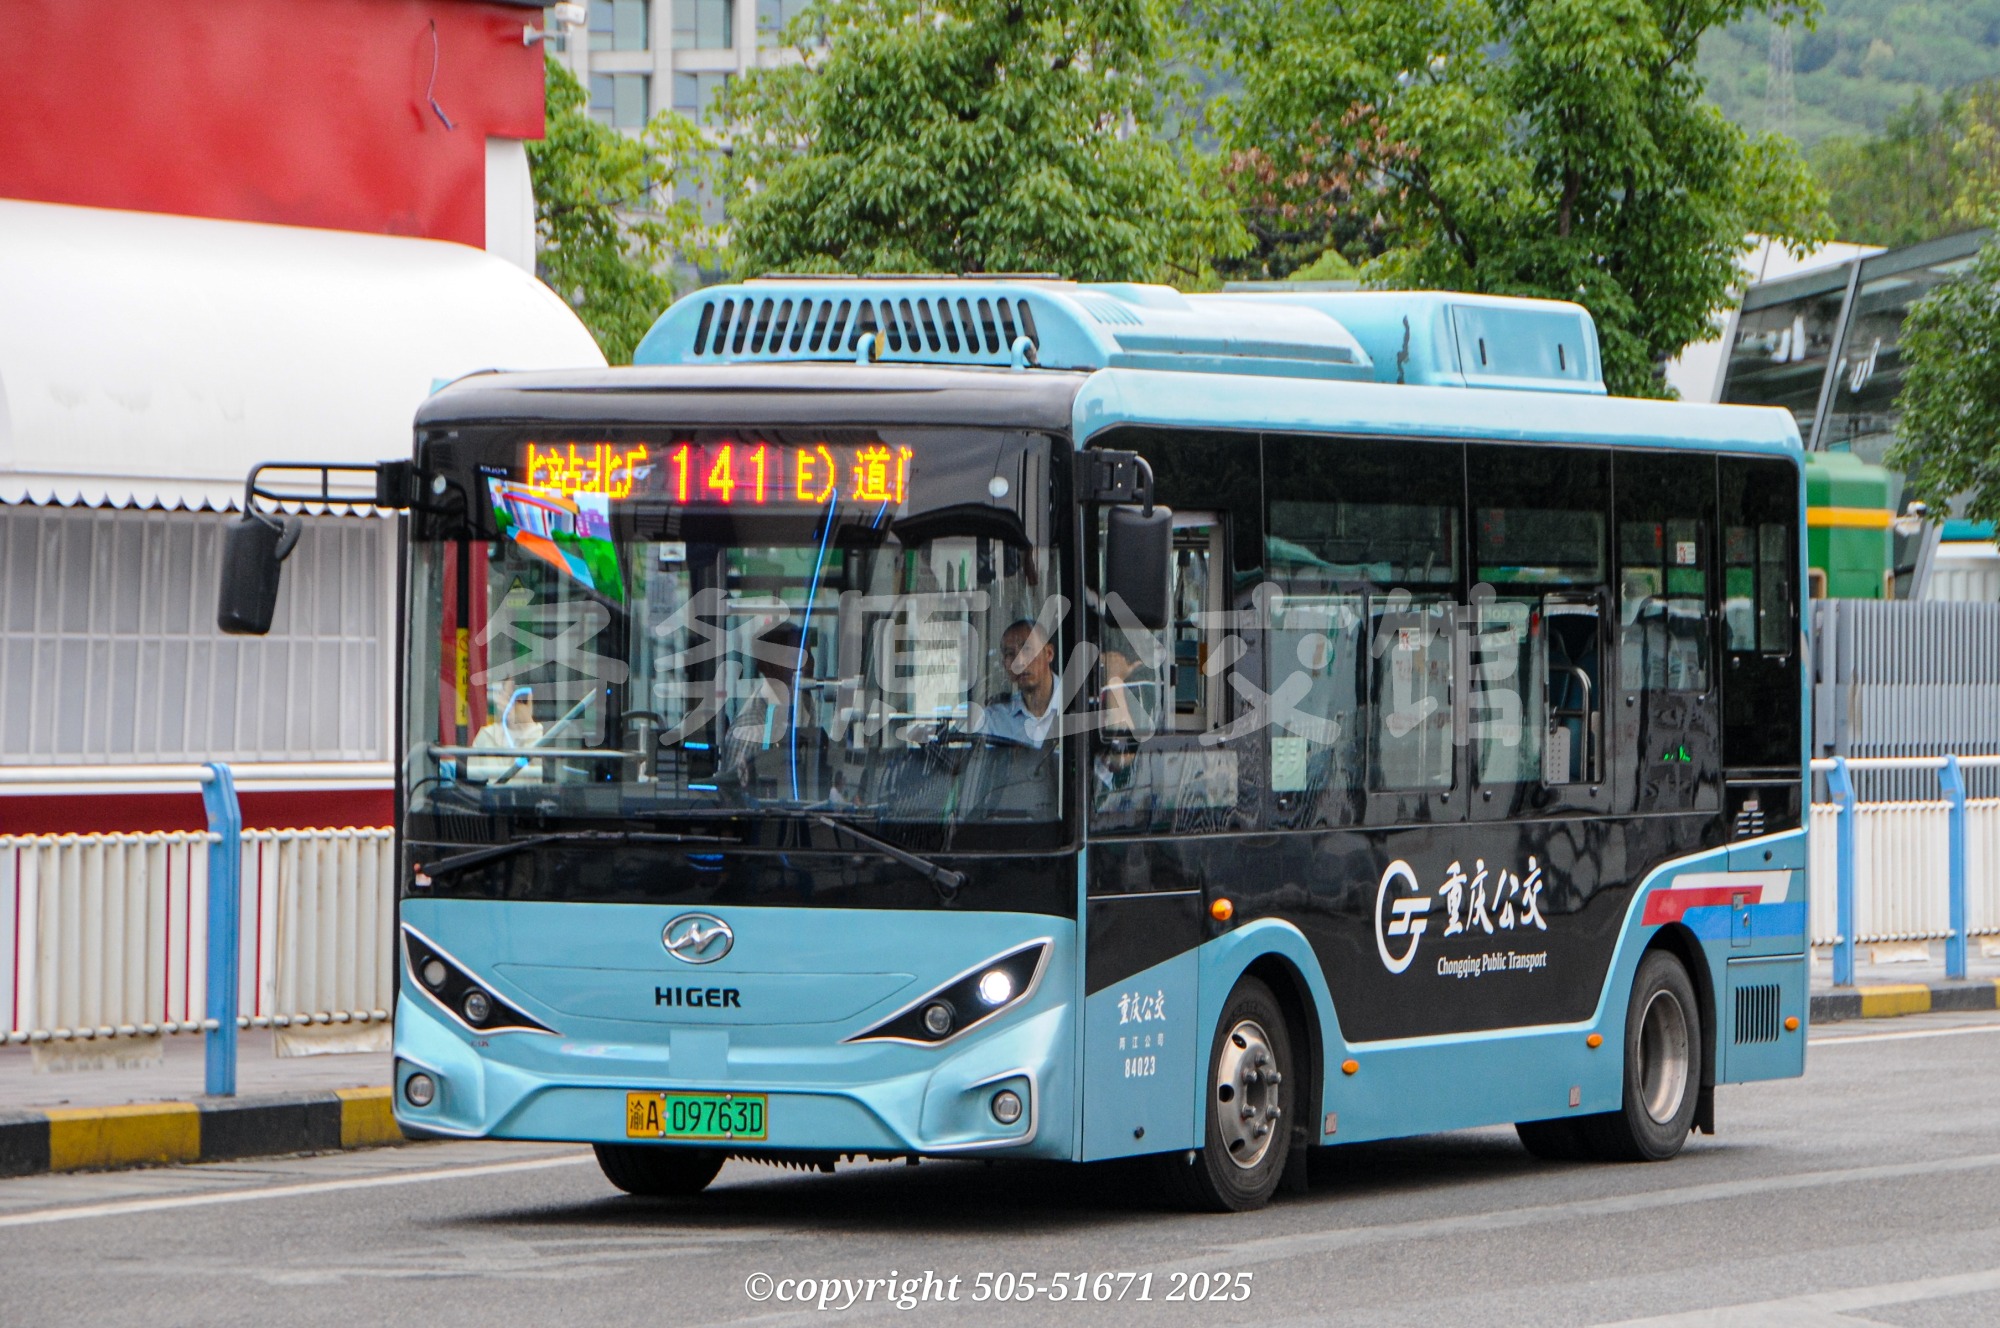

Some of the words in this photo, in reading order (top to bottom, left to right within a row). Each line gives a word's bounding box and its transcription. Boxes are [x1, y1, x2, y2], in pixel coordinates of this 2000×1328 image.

[671, 444, 768, 504] 141
[1438, 854, 1547, 938] 重庆公交
[1437, 955, 1481, 979] Chongqing
[1482, 952, 1507, 972] Public
[1507, 950, 1547, 973] Transport
[654, 986, 741, 1008] HIGER
[1117, 989, 1166, 1026] 重庆公交
[1124, 1055, 1156, 1079] 84023
[672, 1101, 763, 1133] 09763D
